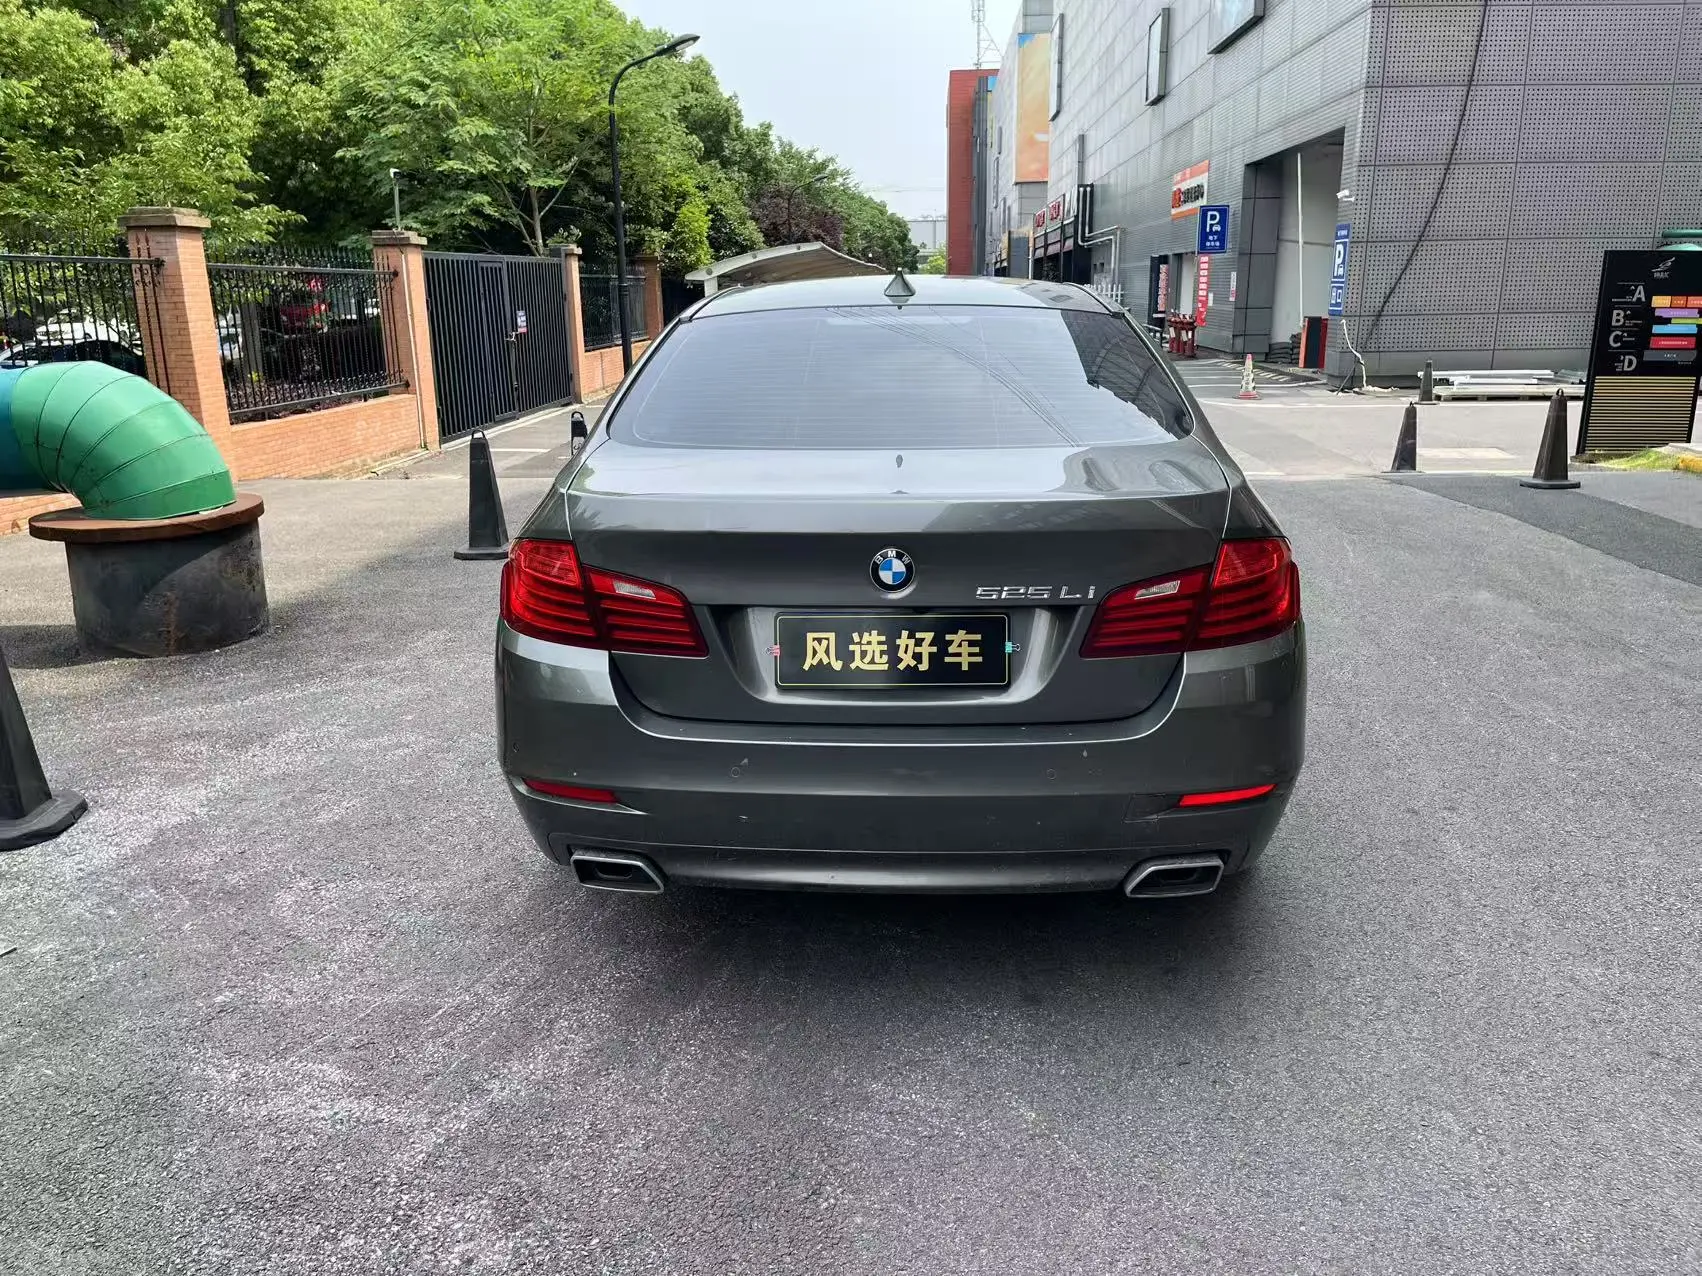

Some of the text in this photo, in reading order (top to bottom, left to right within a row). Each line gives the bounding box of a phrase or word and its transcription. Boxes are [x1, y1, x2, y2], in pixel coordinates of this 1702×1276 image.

[1206, 211, 1220, 232] P
[1334, 243, 1344, 276] P
[1632, 285, 1646, 302] A
[1612, 309, 1625, 326] B
[1609, 331, 1622, 347] C
[1623, 355, 1637, 371] D
[875, 550, 911, 565] BMW
[975, 585, 1096, 601] 525 Li
[802, 630, 984, 671] 风选好车
